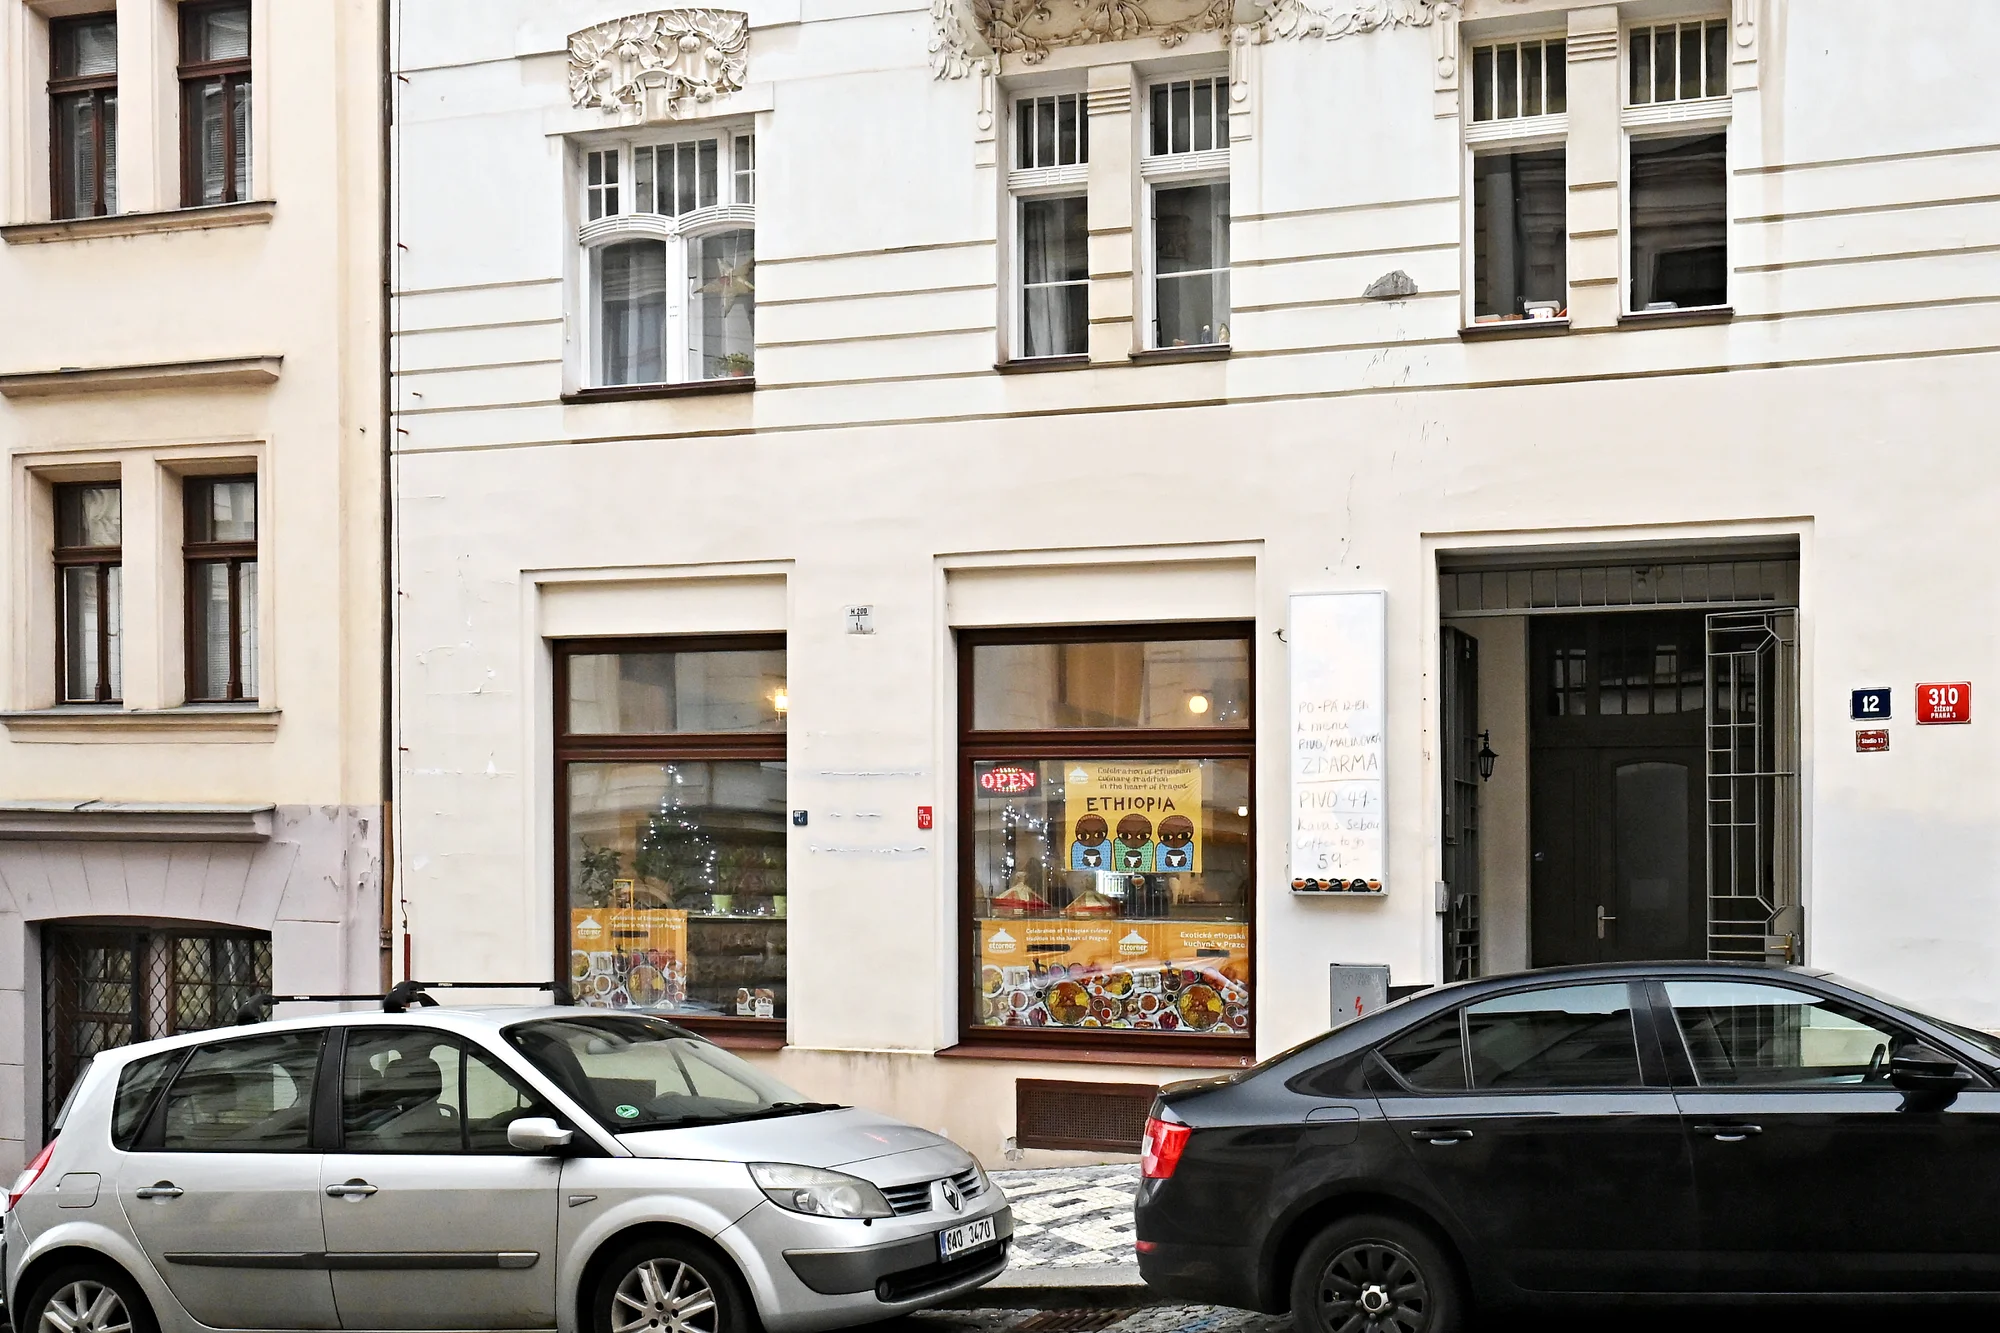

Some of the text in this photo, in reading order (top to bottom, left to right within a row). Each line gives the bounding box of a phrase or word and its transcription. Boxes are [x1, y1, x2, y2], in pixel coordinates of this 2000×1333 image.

[1862, 695, 1880, 713] 12
[1928, 687, 1959, 706] 310
[1951, 711, 1956, 719] 3
[1301, 752, 1378, 775] ZDARMA
[980, 772, 1036, 789] OPEN
[1086, 796, 1176, 813] ETHIOPIA
[1299, 789, 1338, 808] PIVO
[1223, 941, 1246, 949] Praze
[968, 1220, 991, 1244] 3470
